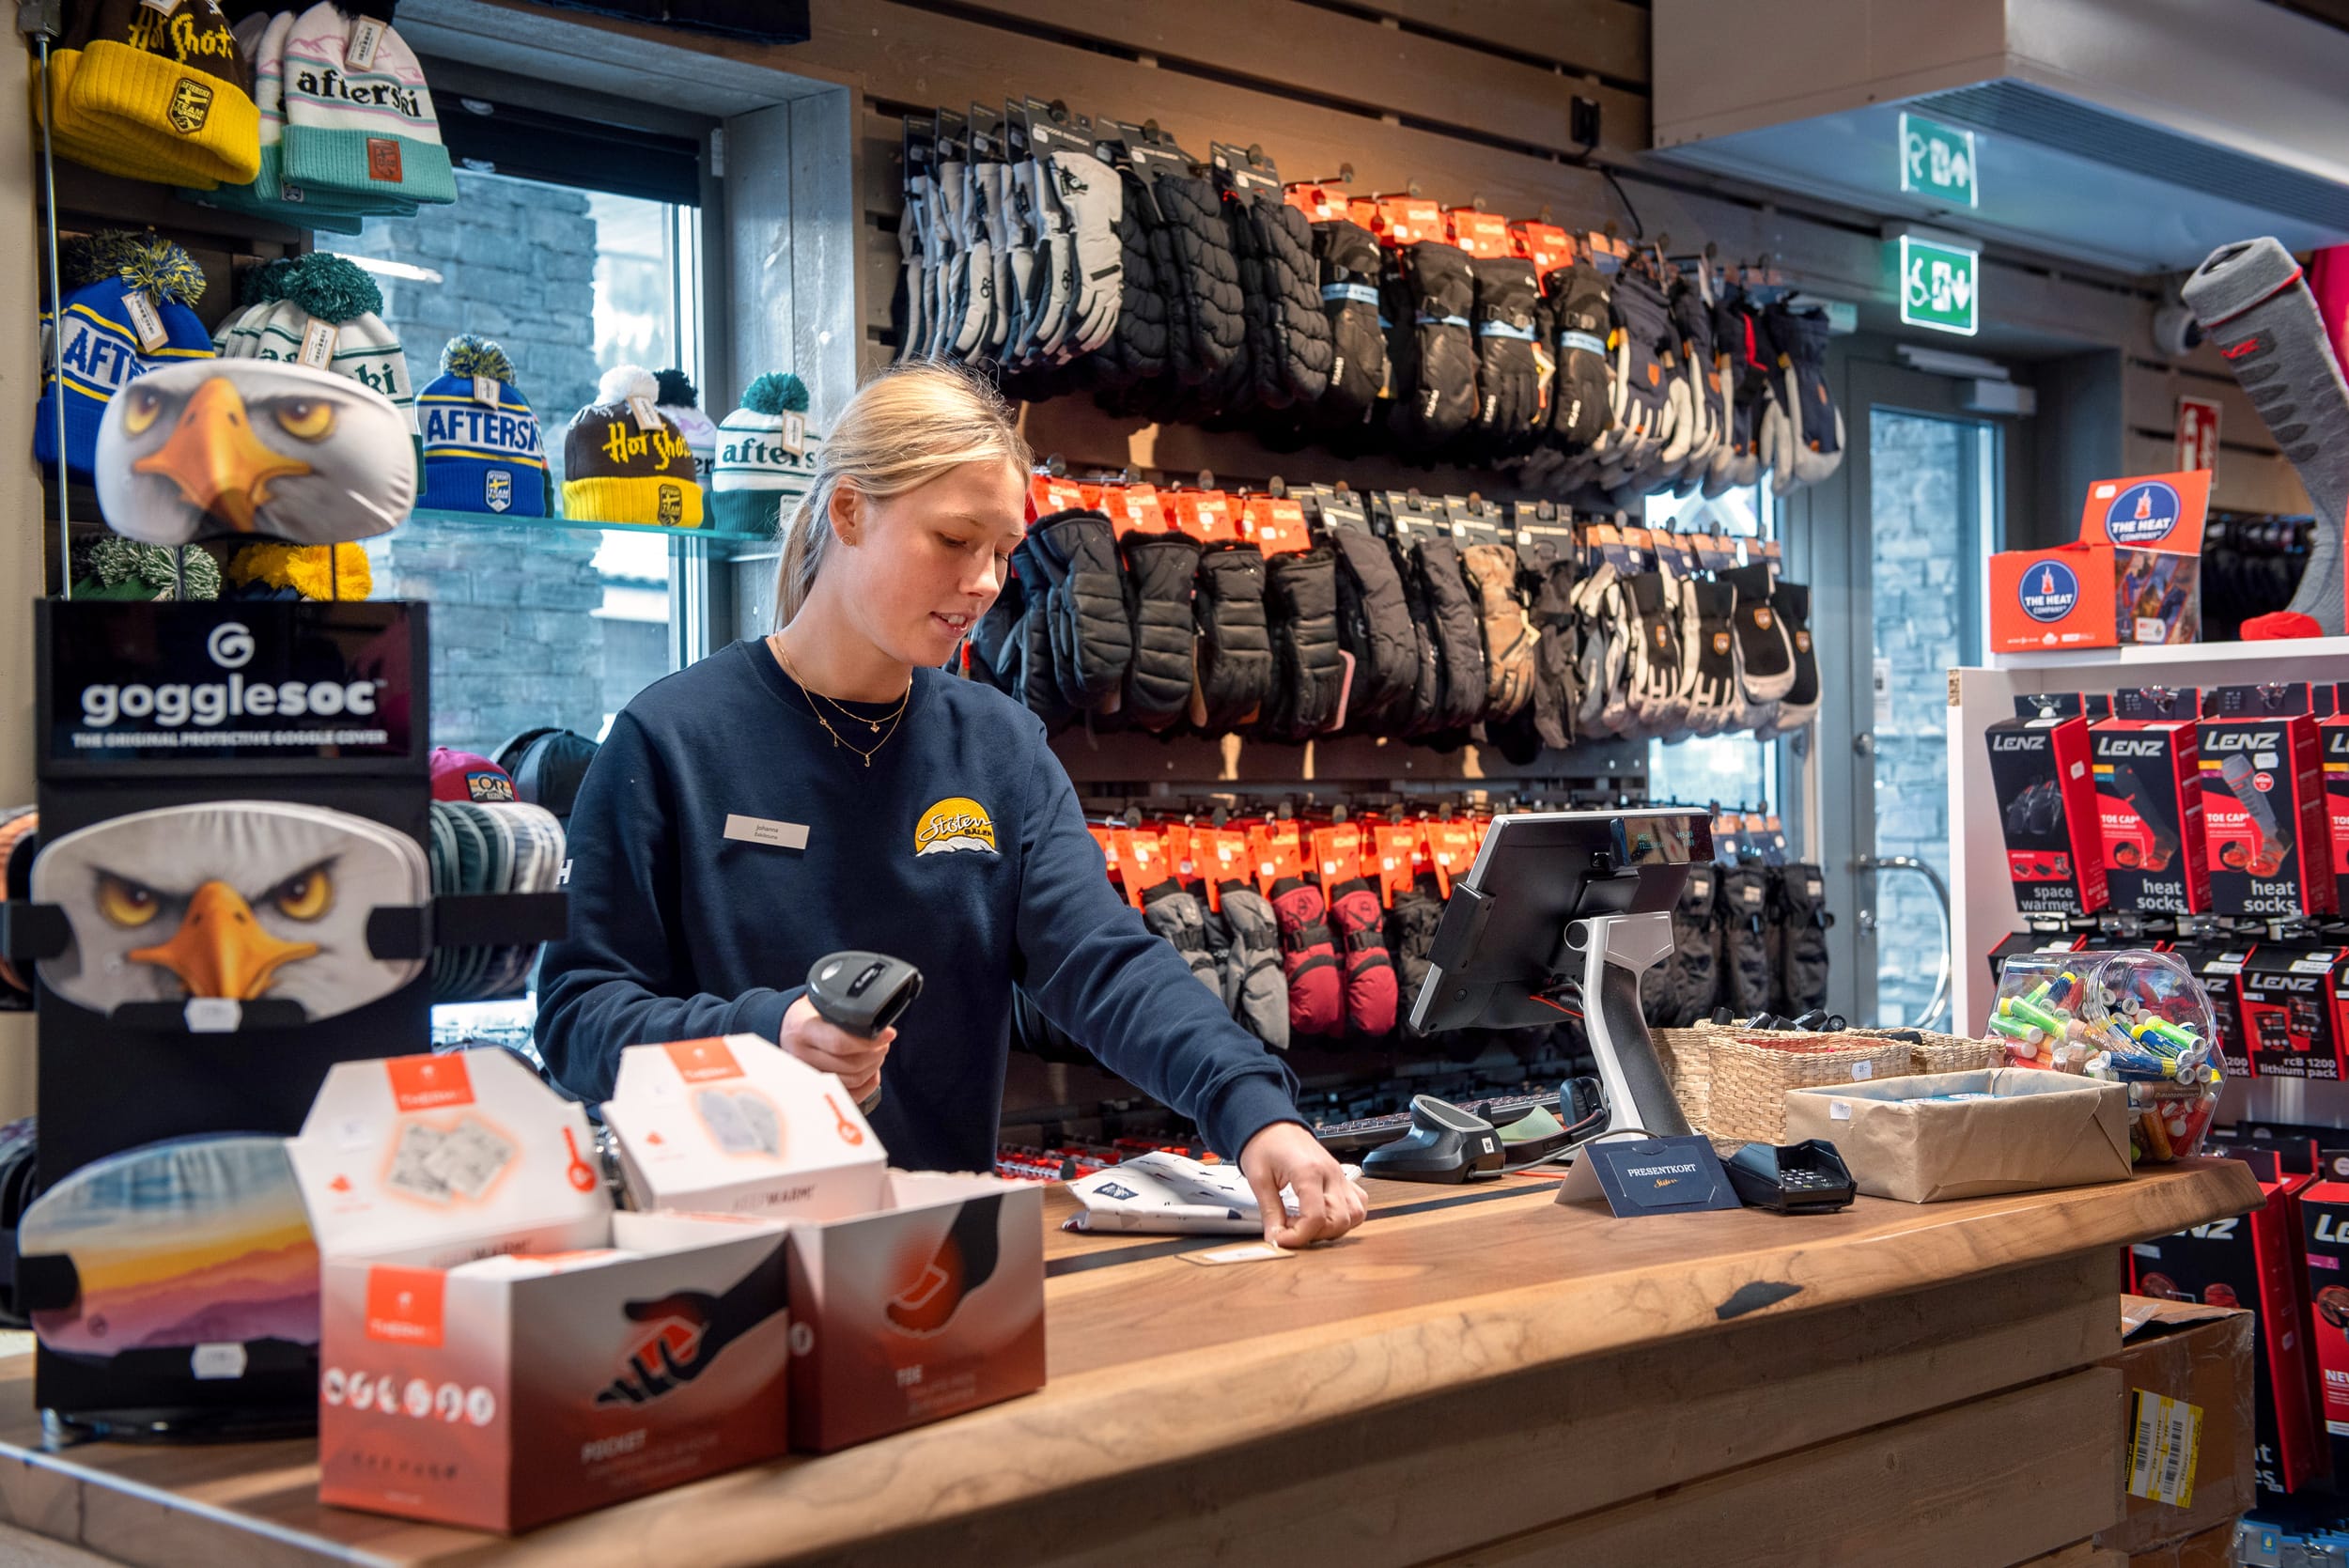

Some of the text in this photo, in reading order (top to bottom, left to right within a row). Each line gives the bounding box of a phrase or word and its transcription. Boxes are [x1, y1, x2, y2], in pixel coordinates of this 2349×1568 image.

[2111, 517, 2172, 534] THE HEAT
[2024, 594, 2073, 607] THE HEAT
[81, 673, 376, 727] gogglesoc
[1993, 735, 2046, 752] LENZ
[2097, 737, 2165, 756] LENZ
[2204, 730, 2281, 752] LENZ
[2101, 814, 2118, 824] TOE
[2206, 813, 2225, 823] TOE
[919, 814, 995, 842] Stöten
[2142, 878, 2183, 894] heat
[2250, 879, 2295, 895] heat
[2033, 887, 2074, 901] space
[2021, 900, 2076, 911] warmer
[2136, 895, 2185, 910] socks
[2243, 896, 2297, 912] socks
[2249, 972, 2318, 992] LENZ
[2227, 1057, 2248, 1066] 200
[2307, 1058, 2336, 1068] 1200
[2227, 1066, 2250, 1077] ack
[2260, 1064, 2338, 1079] lithium pack
[1626, 1163, 1696, 1177] PRESENTKORT
